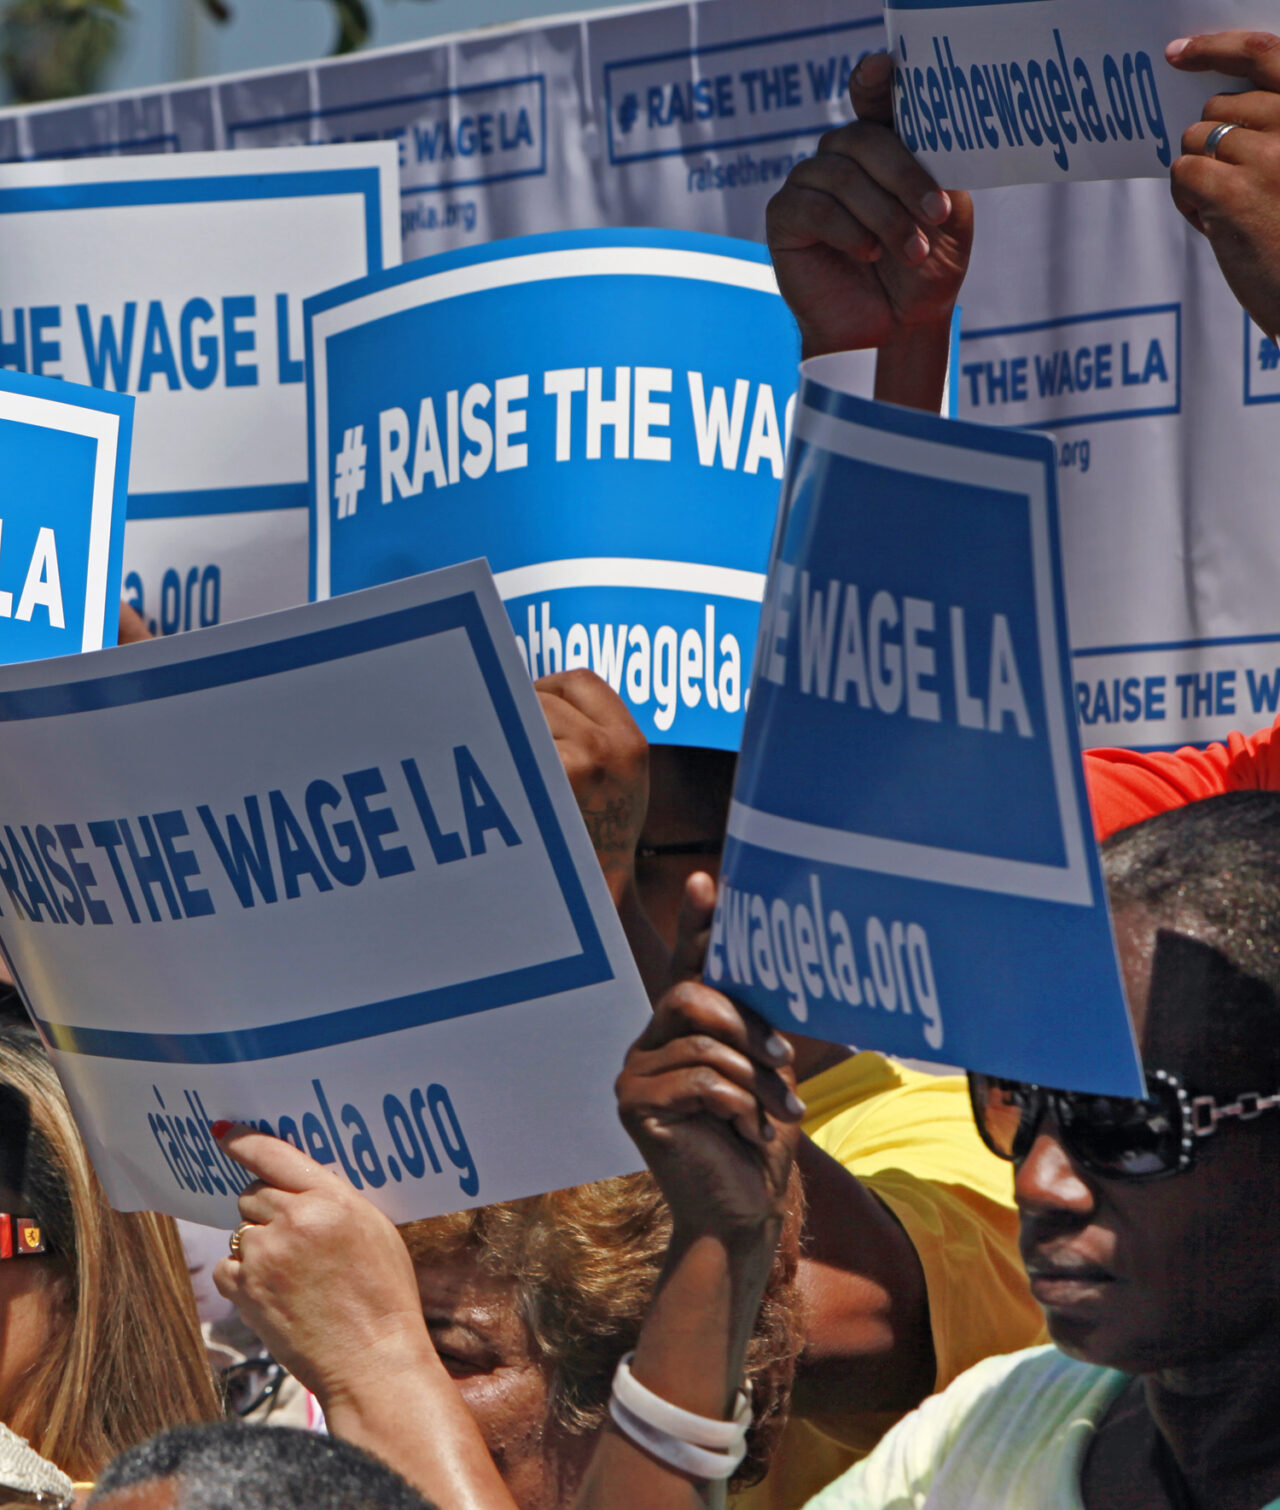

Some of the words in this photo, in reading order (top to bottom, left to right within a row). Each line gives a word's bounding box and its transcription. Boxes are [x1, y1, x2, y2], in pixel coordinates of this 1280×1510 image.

[413, 112, 495, 164] WAGE
[498, 107, 534, 151] LA
[646, 73, 736, 129] RAISE
[739, 62, 802, 114] THE
[892, 28, 1171, 171] aisethewagela.org
[75, 294, 259, 393] WAGE
[275, 292, 305, 385] L
[962, 356, 1028, 407] THE
[1034, 344, 1113, 399] WAGE
[1121, 338, 1169, 387] LA
[379, 374, 529, 505] RAISE
[543, 366, 673, 462] THE
[687, 370, 797, 479] WA
[800, 569, 942, 723] WAGE
[949, 605, 1035, 739] LA
[1075, 676, 1166, 725] RAISE
[1175, 670, 1236, 719] THE
[86, 809, 216, 924] THE
[195, 766, 416, 909] WAGE
[400, 744, 523, 865] LA
[708, 873, 944, 1050] ewagela.org
